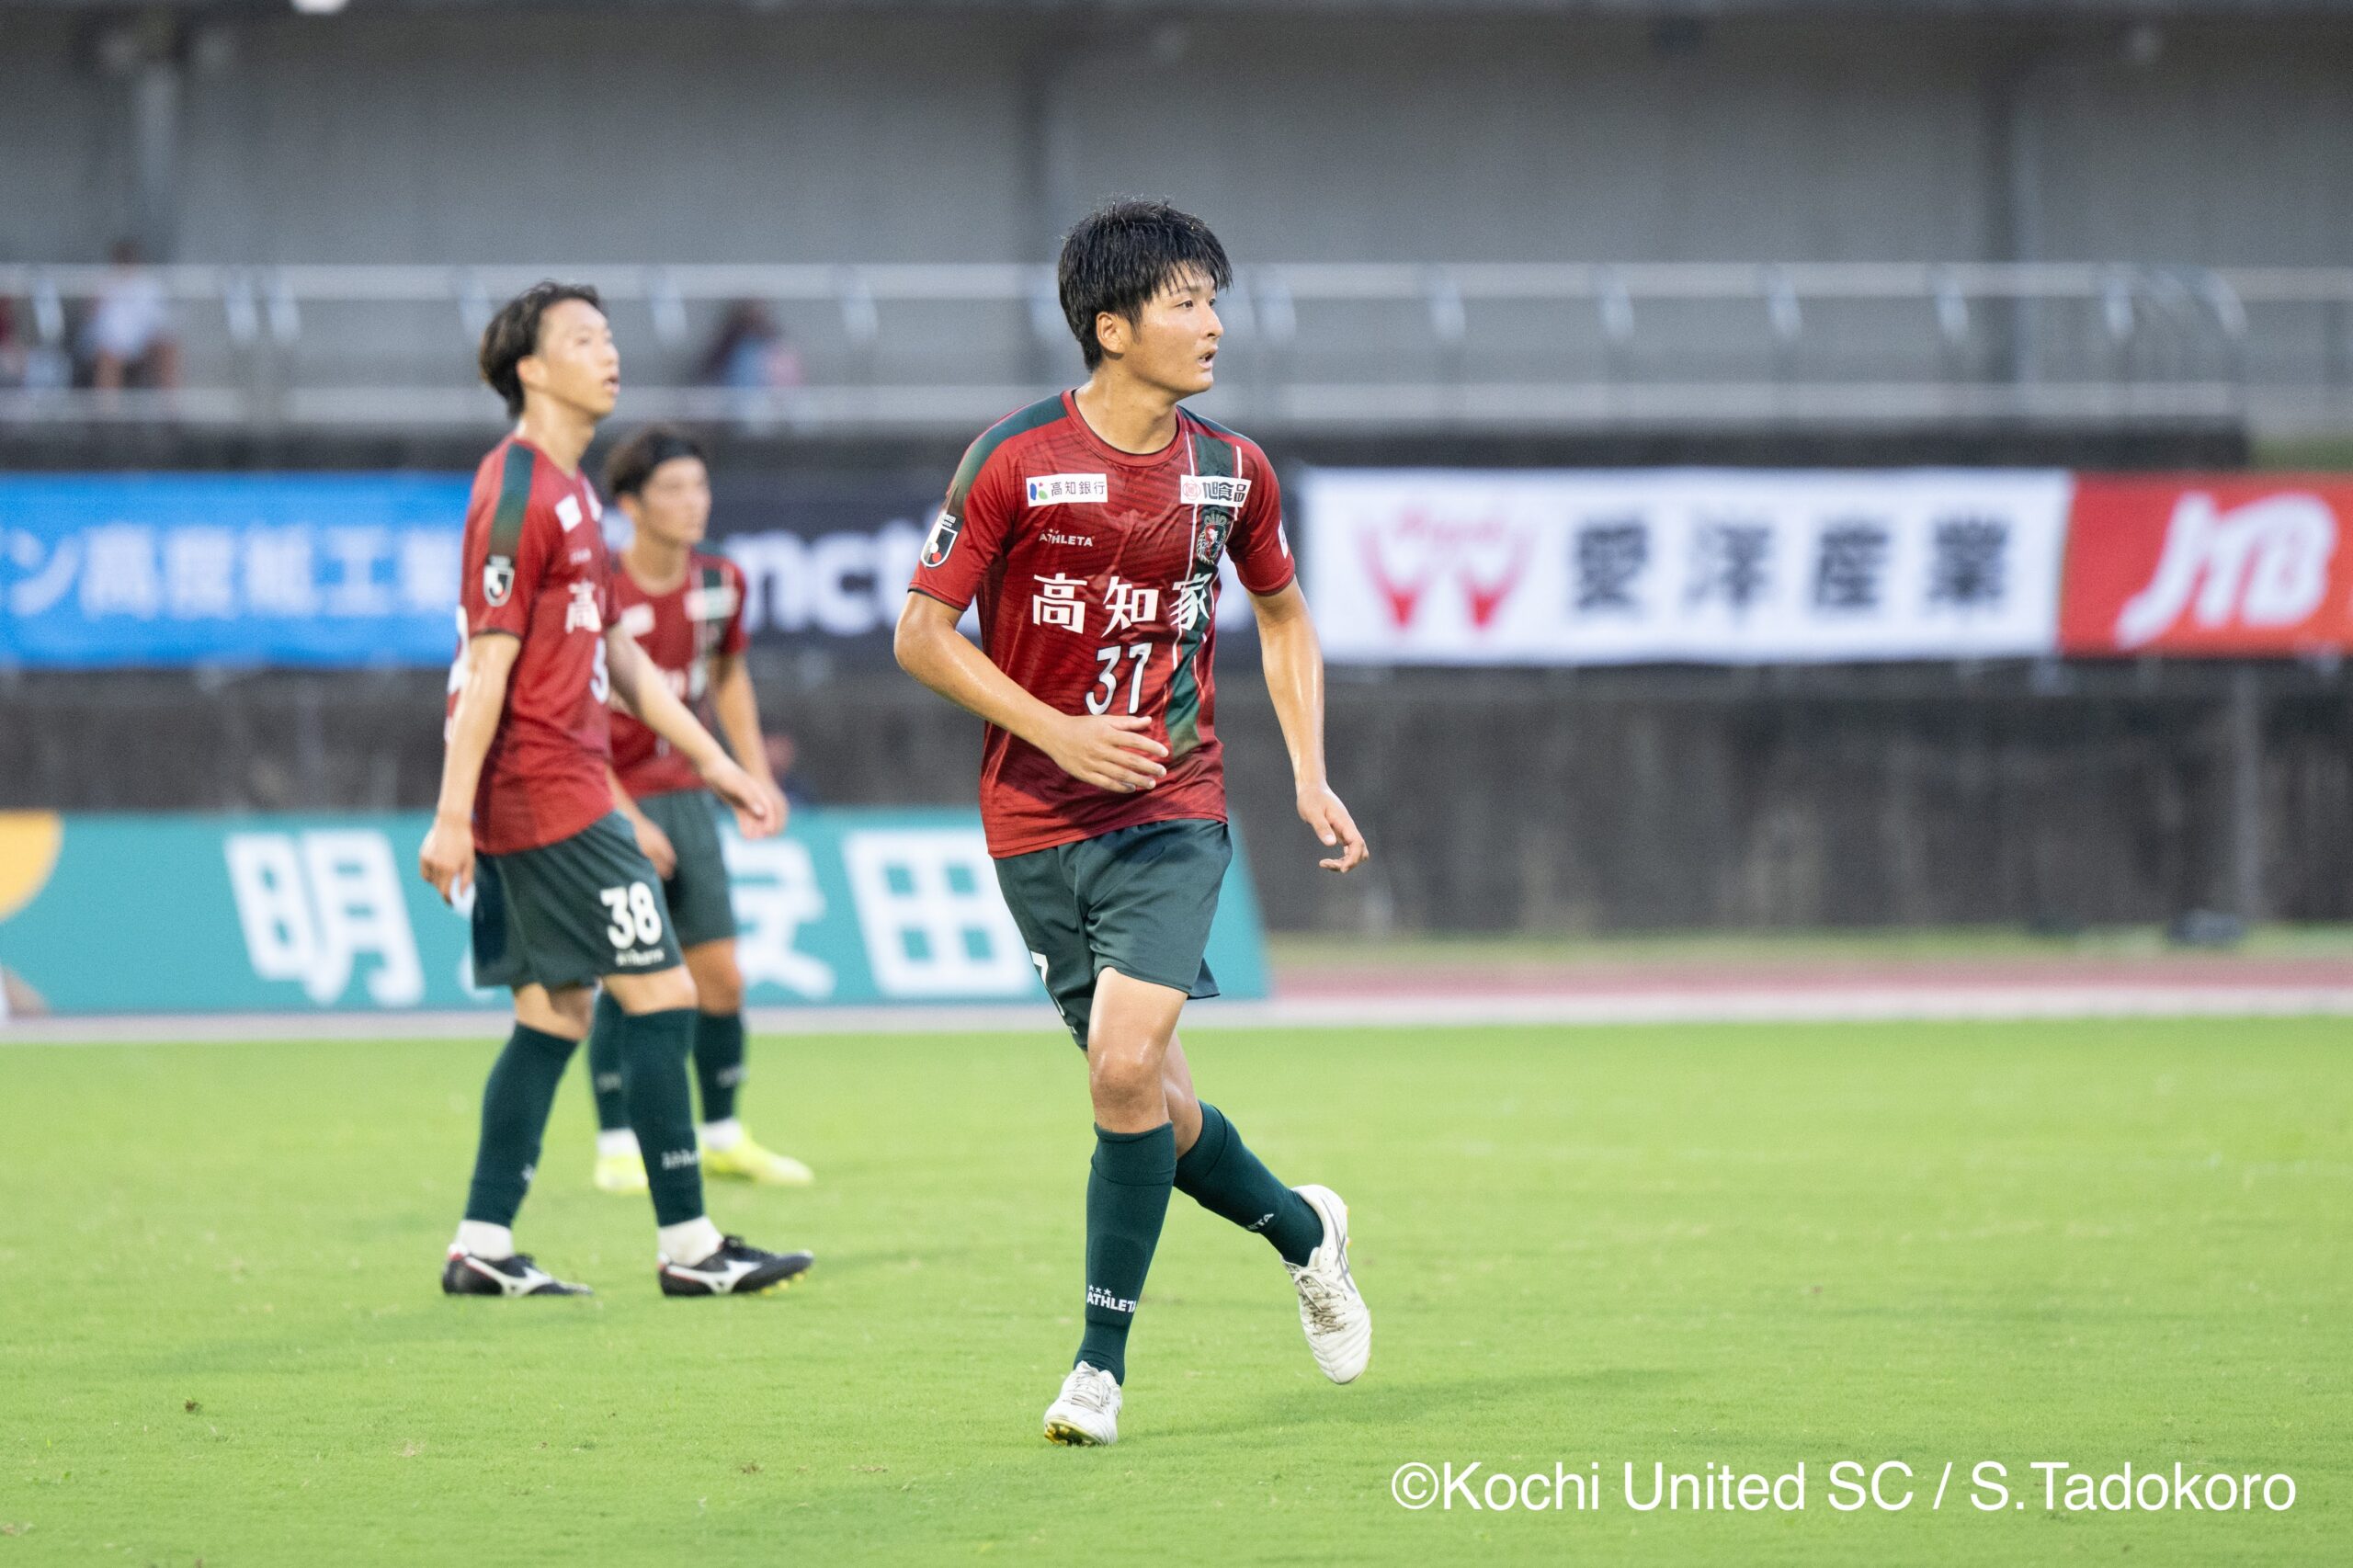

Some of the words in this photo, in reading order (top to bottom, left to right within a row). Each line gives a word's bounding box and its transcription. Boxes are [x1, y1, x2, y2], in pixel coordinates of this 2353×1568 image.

[1051, 481, 1105, 497] 高知銀行
[1202, 482, 1247, 503] 旭食品
[1039, 533, 1094, 547] ATHLETA
[2114, 491, 2338, 648] JTB
[1032, 573, 1213, 638] 高知家
[1085, 642, 1153, 715] 37
[600, 881, 662, 949] 38
